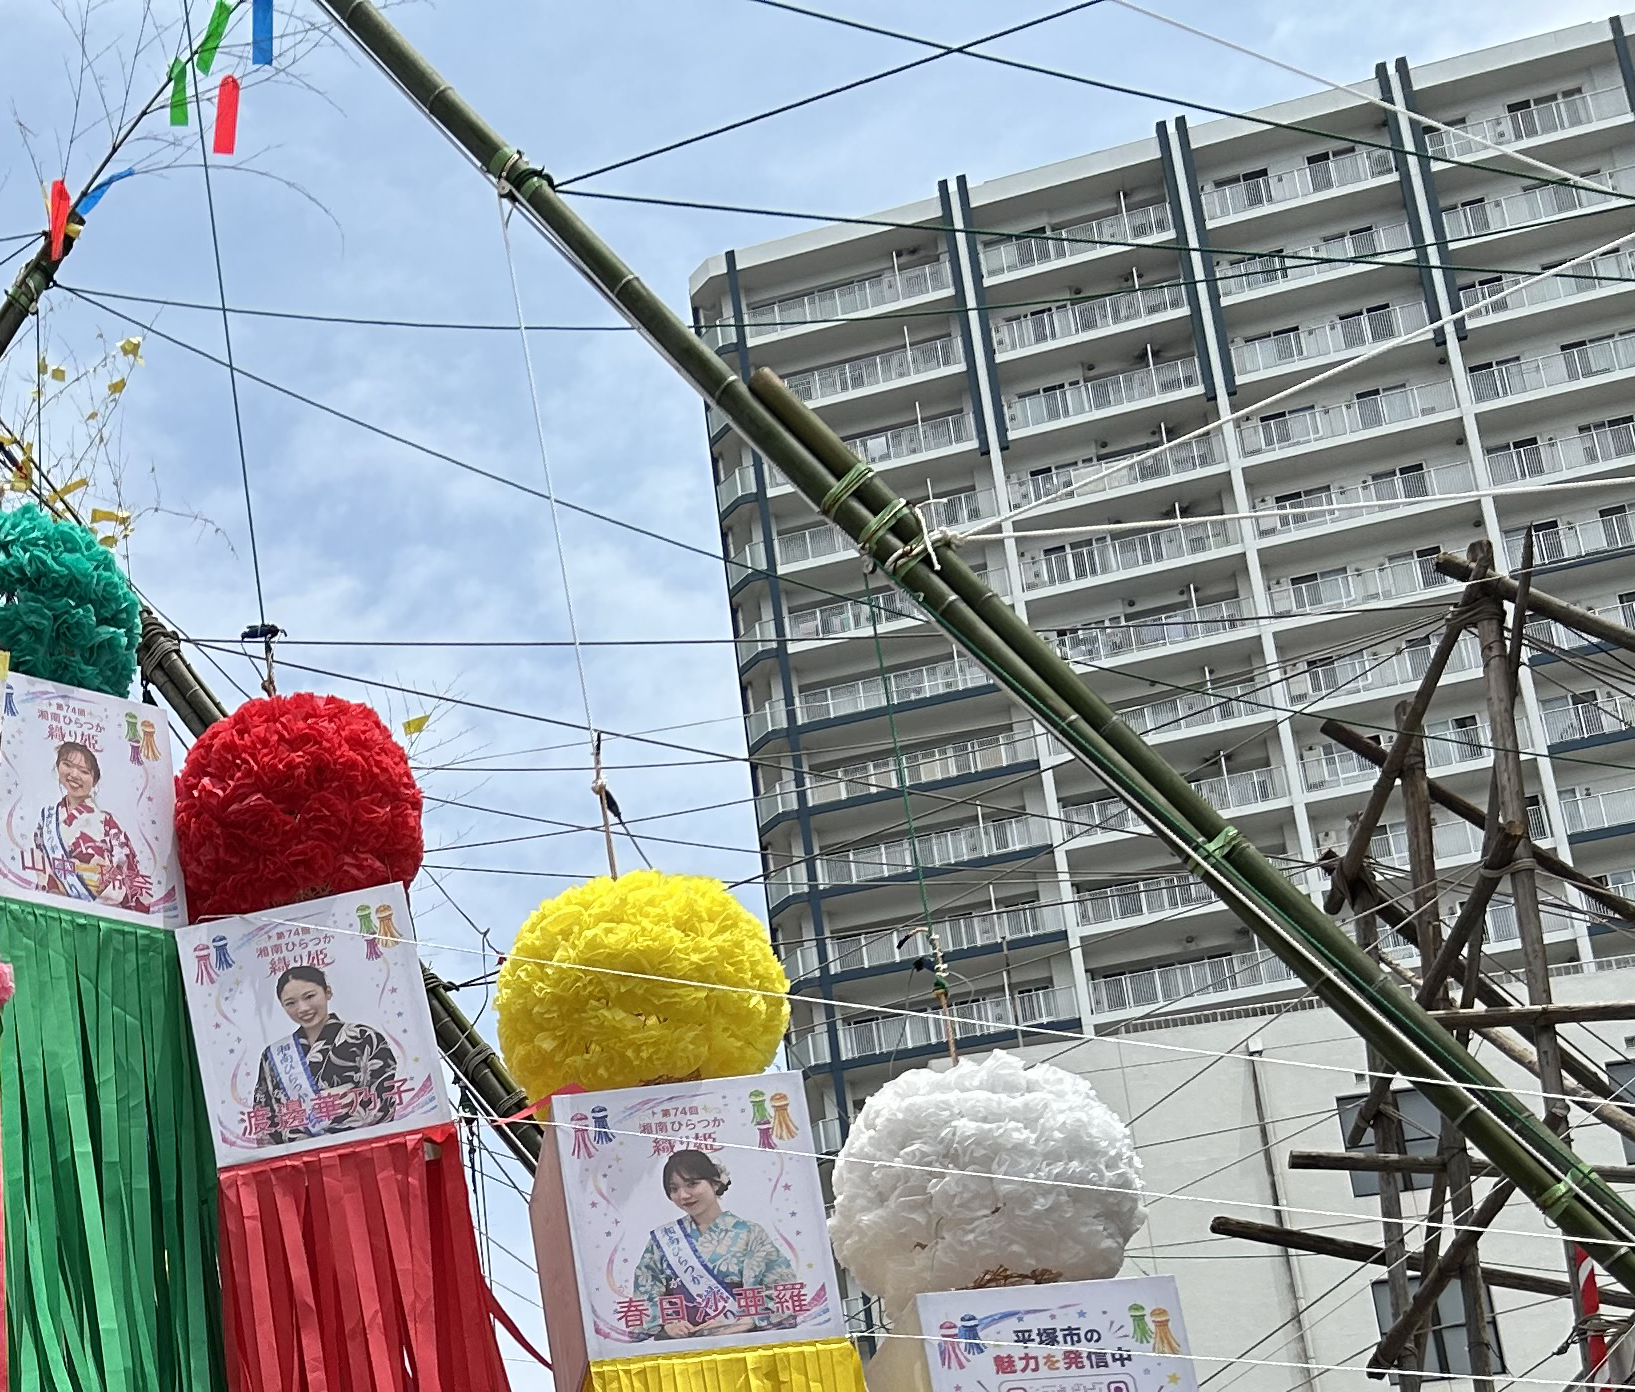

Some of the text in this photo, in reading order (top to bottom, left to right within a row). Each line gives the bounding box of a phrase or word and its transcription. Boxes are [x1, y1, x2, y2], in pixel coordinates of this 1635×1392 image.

[255, 931, 336, 959] 湘南ひらつか
[265, 948, 336, 979] 織り姫
[660, 1105, 700, 1118] 第74回
[639, 1116, 726, 1135] 湘南ひらつか
[1012, 1325, 1103, 1350] 平塚市の
[993, 1346, 1133, 1376] 魅力を発信中
